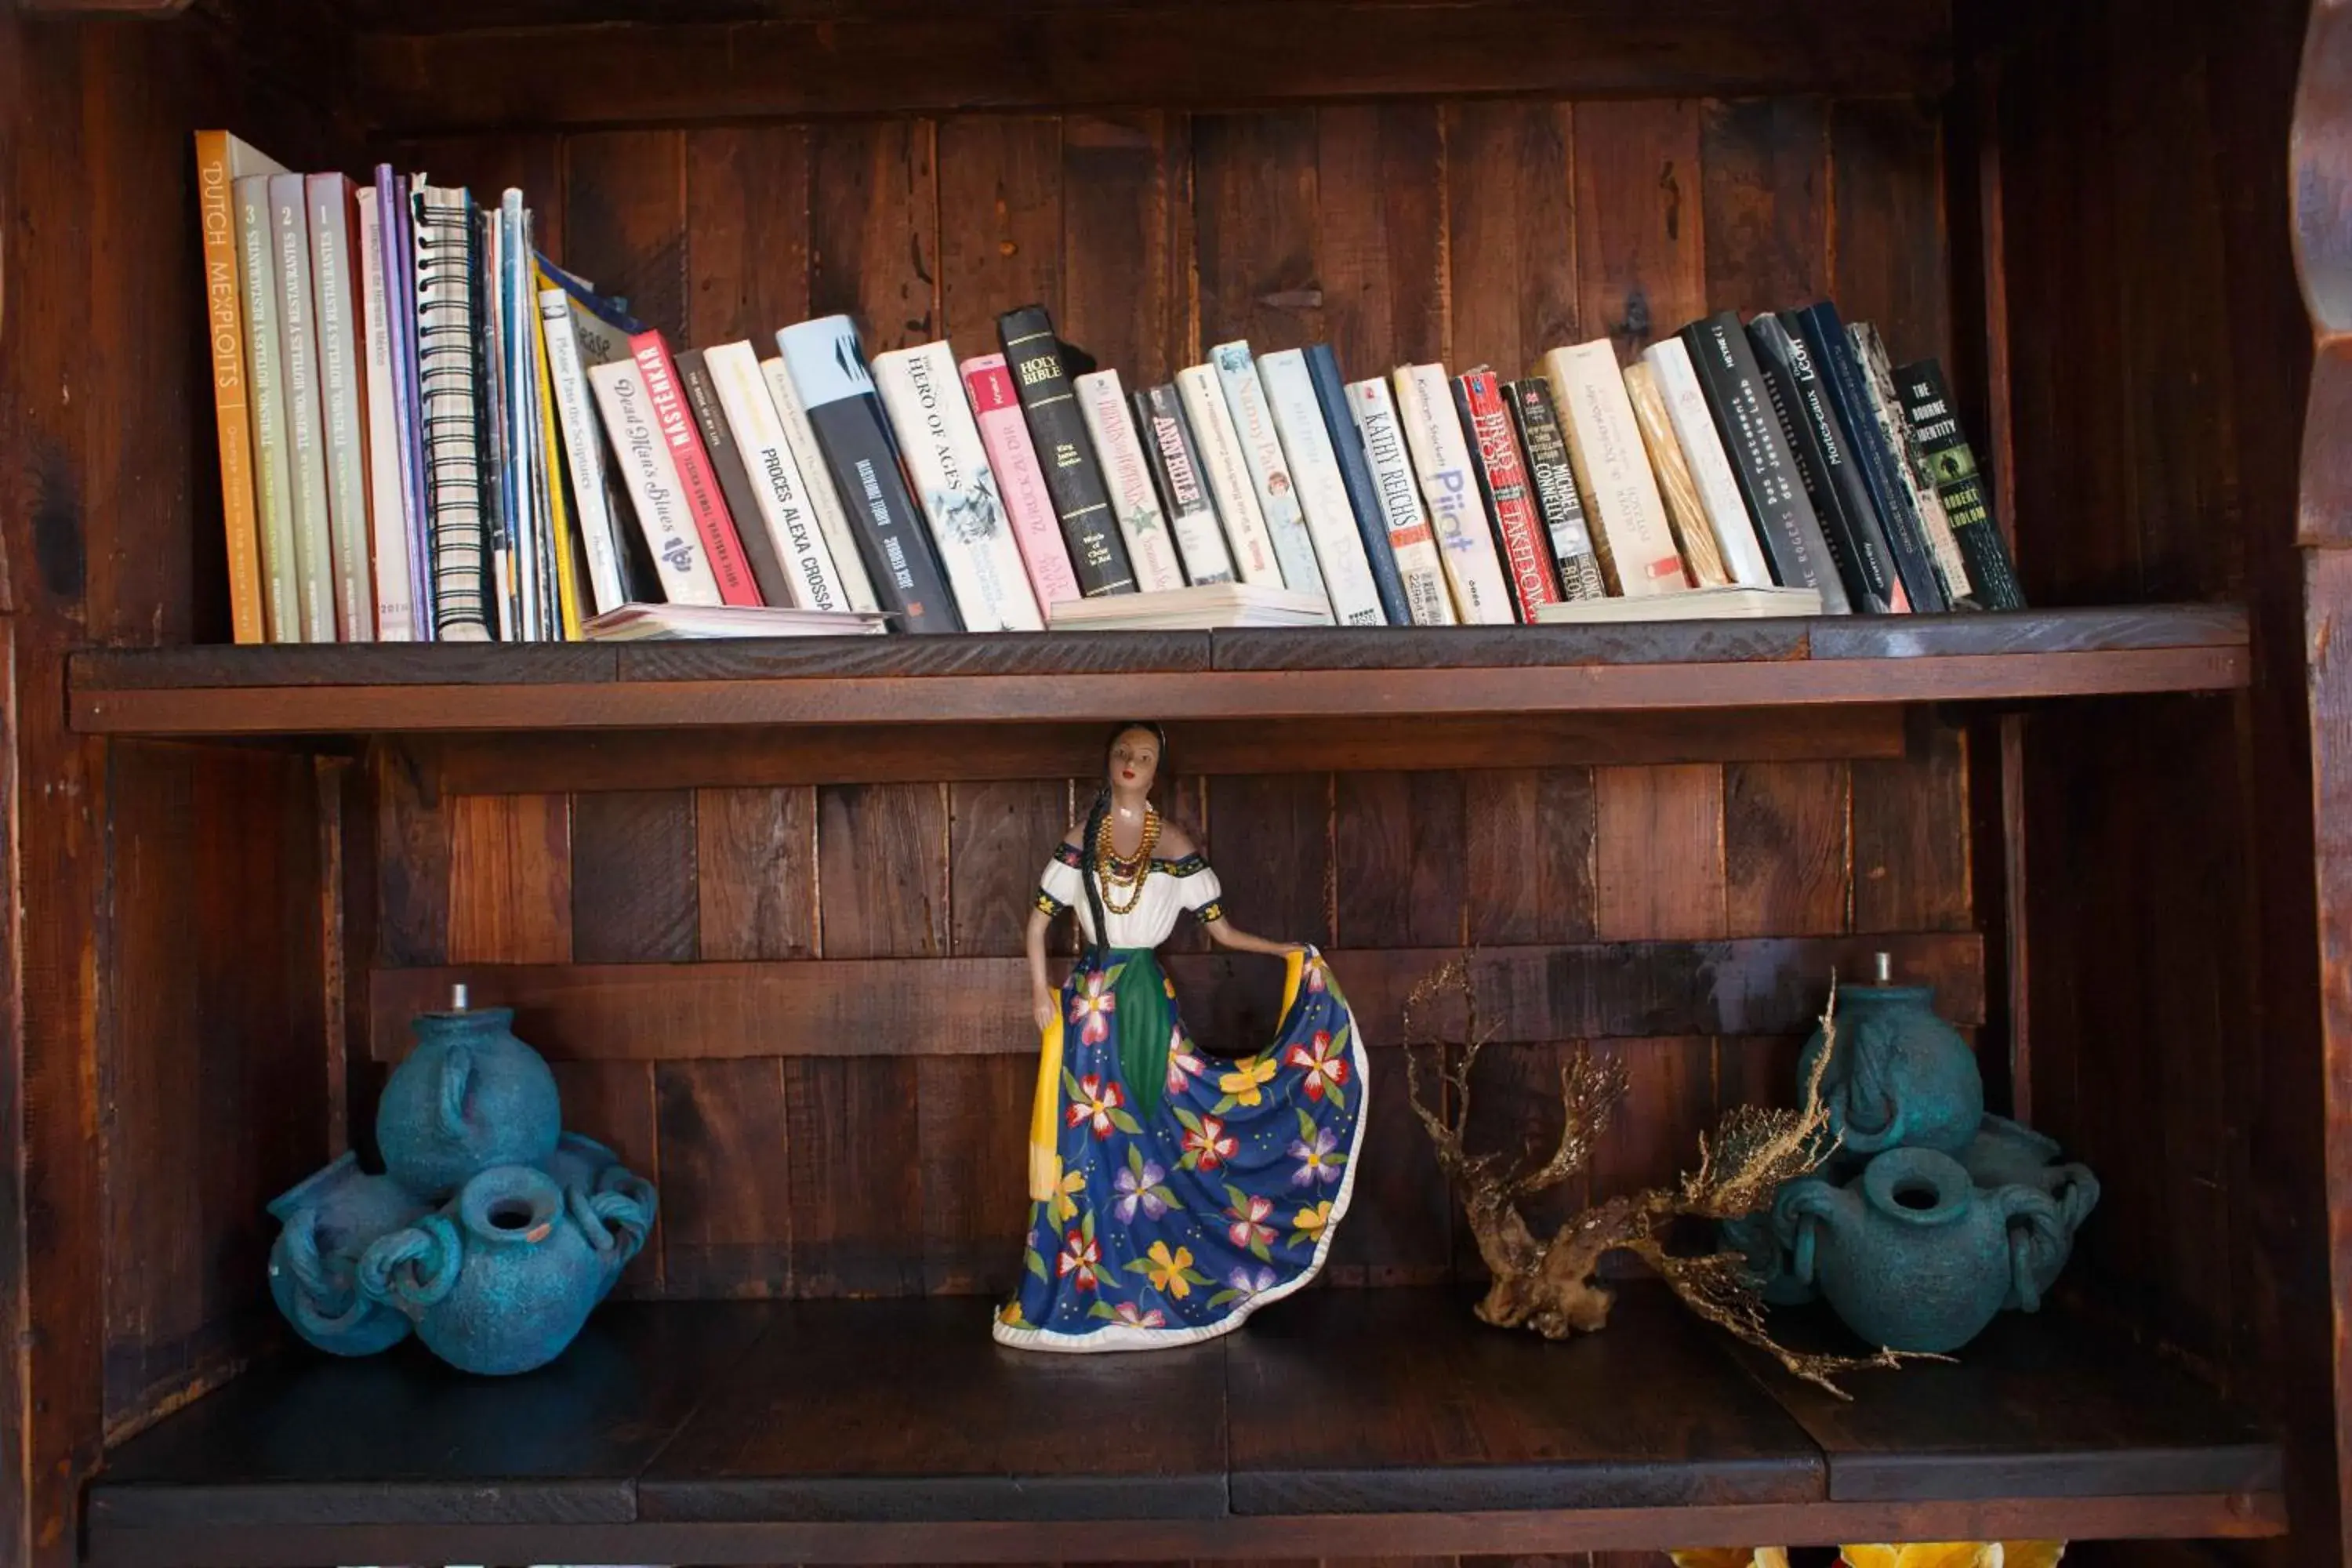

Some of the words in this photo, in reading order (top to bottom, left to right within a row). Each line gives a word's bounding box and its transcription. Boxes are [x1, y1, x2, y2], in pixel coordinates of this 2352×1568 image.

[201, 162, 227, 245] DUTCH
[245, 205, 255, 223] 3
[283, 207, 291, 224] 2
[321, 206, 326, 223] 1
[210, 263, 238, 387] MEXPLOITS
[575, 312, 611, 357] lease
[1020, 355, 1057, 374] HOLY
[1023, 366, 1062, 386] BIBLE
[1788, 339, 1814, 383] Leon
[614, 379, 643, 423] Dead
[695, 387, 706, 406] BOOK
[1741, 380, 1759, 412] Lamb
[1912, 382, 1929, 397] THE
[1912, 401, 1949, 421] BOURNE
[556, 337, 568, 373] Please
[563, 378, 574, 403] Pass
[569, 407, 579, 426] the
[574, 429, 591, 489] Scriptures
[700, 407, 710, 418] OF
[909, 358, 935, 408] HERO
[928, 414, 946, 437] OF
[938, 447, 959, 489] AGES
[1237, 377, 1262, 438] Nanny
[1258, 443, 1277, 471] Pat
[1917, 419, 1956, 443] IDENTITY
[626, 426, 658, 477] Man's
[710, 432, 720, 445] LIFE
[1004, 426, 1020, 450] DIR
[1153, 417, 1185, 456] ANN
[1365, 412, 1399, 464] KATHY
[1472, 411, 1501, 475] THOR
[1486, 408, 1517, 473] BRAD
[1733, 398, 1765, 474] Testament
[1756, 418, 1780, 466] Jessie
[762, 448, 792, 502] PROCES
[782, 509, 811, 554] ALEXA
[1164, 455, 1200, 506] RULE
[1381, 470, 1416, 526] REICHS
[1536, 460, 1563, 524] CONNELLY
[1552, 460, 1578, 514] MICHAEL
[1764, 480, 1777, 504] Das
[1778, 477, 1791, 499] der
[1944, 488, 1979, 510] ROBERT
[645, 482, 673, 532] Blues
[1436, 468, 1474, 554] Piiat
[1783, 512, 1806, 562] ROGERS
[1503, 506, 1548, 618] TAKEDOW
[1560, 566, 1584, 603] BLON
[1578, 568, 1603, 604] CONC
